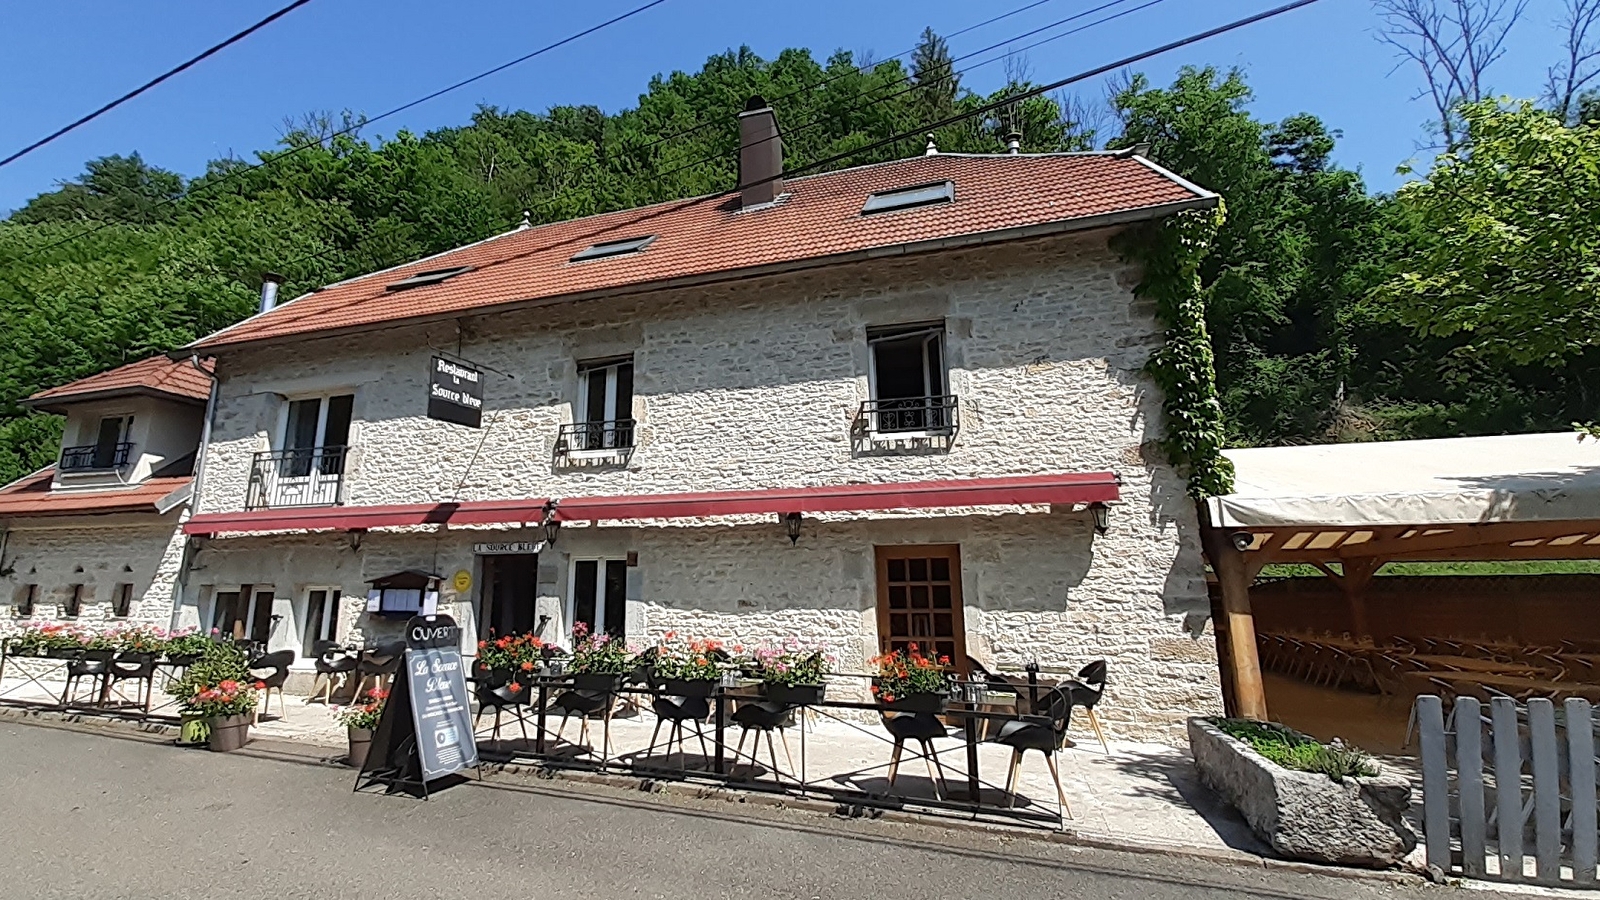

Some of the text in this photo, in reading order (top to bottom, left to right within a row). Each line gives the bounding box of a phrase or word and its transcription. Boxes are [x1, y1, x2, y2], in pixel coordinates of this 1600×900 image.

[437, 360, 478, 382] Restaurant
[432, 383, 460, 402] Source
[412, 626, 456, 640] OUVERT
[414, 660, 429, 676] La
